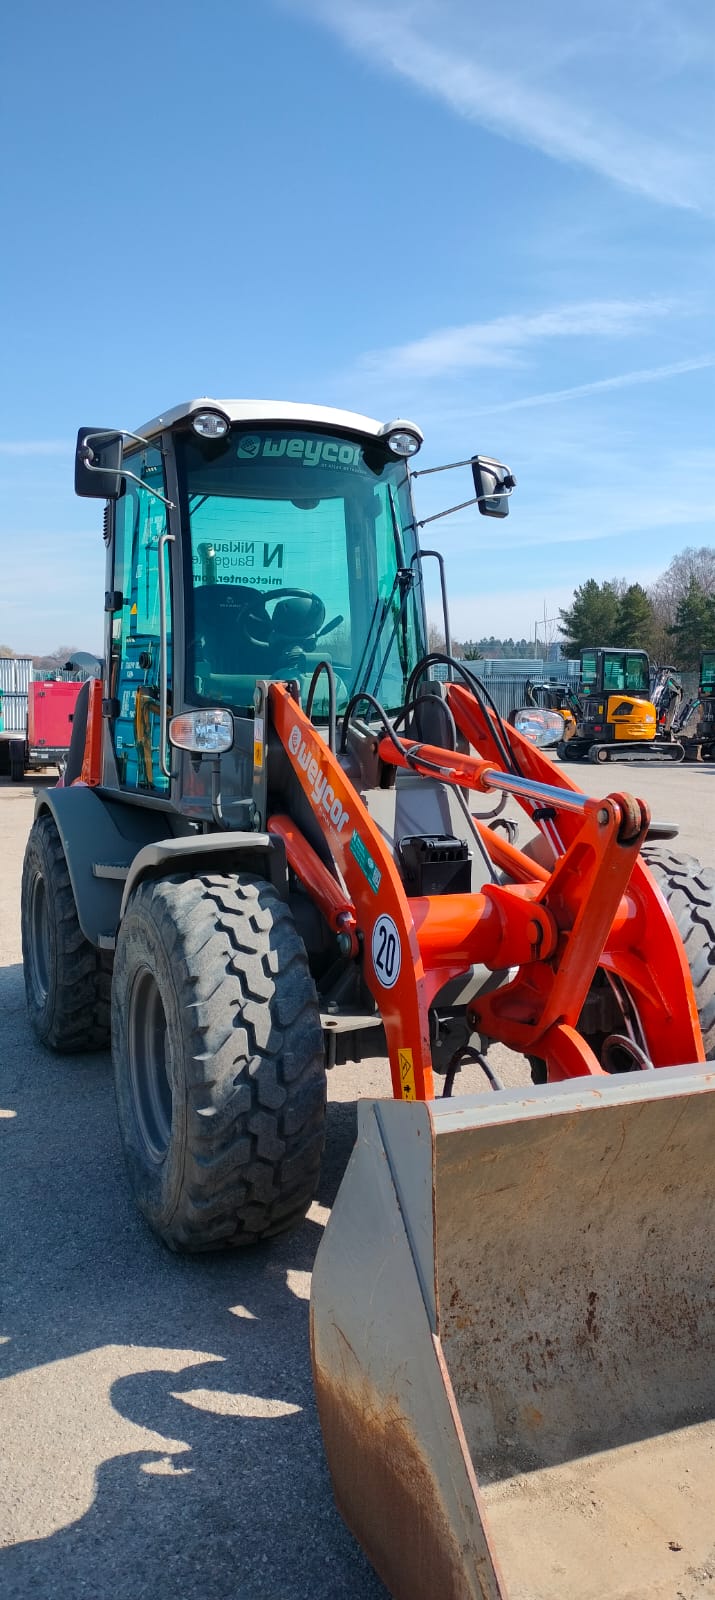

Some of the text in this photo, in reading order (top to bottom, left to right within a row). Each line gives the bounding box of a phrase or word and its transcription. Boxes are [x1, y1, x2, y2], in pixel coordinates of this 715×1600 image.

[262, 438, 364, 466] weycor
[297, 741, 349, 832] weycor
[376, 925, 396, 977] 20
